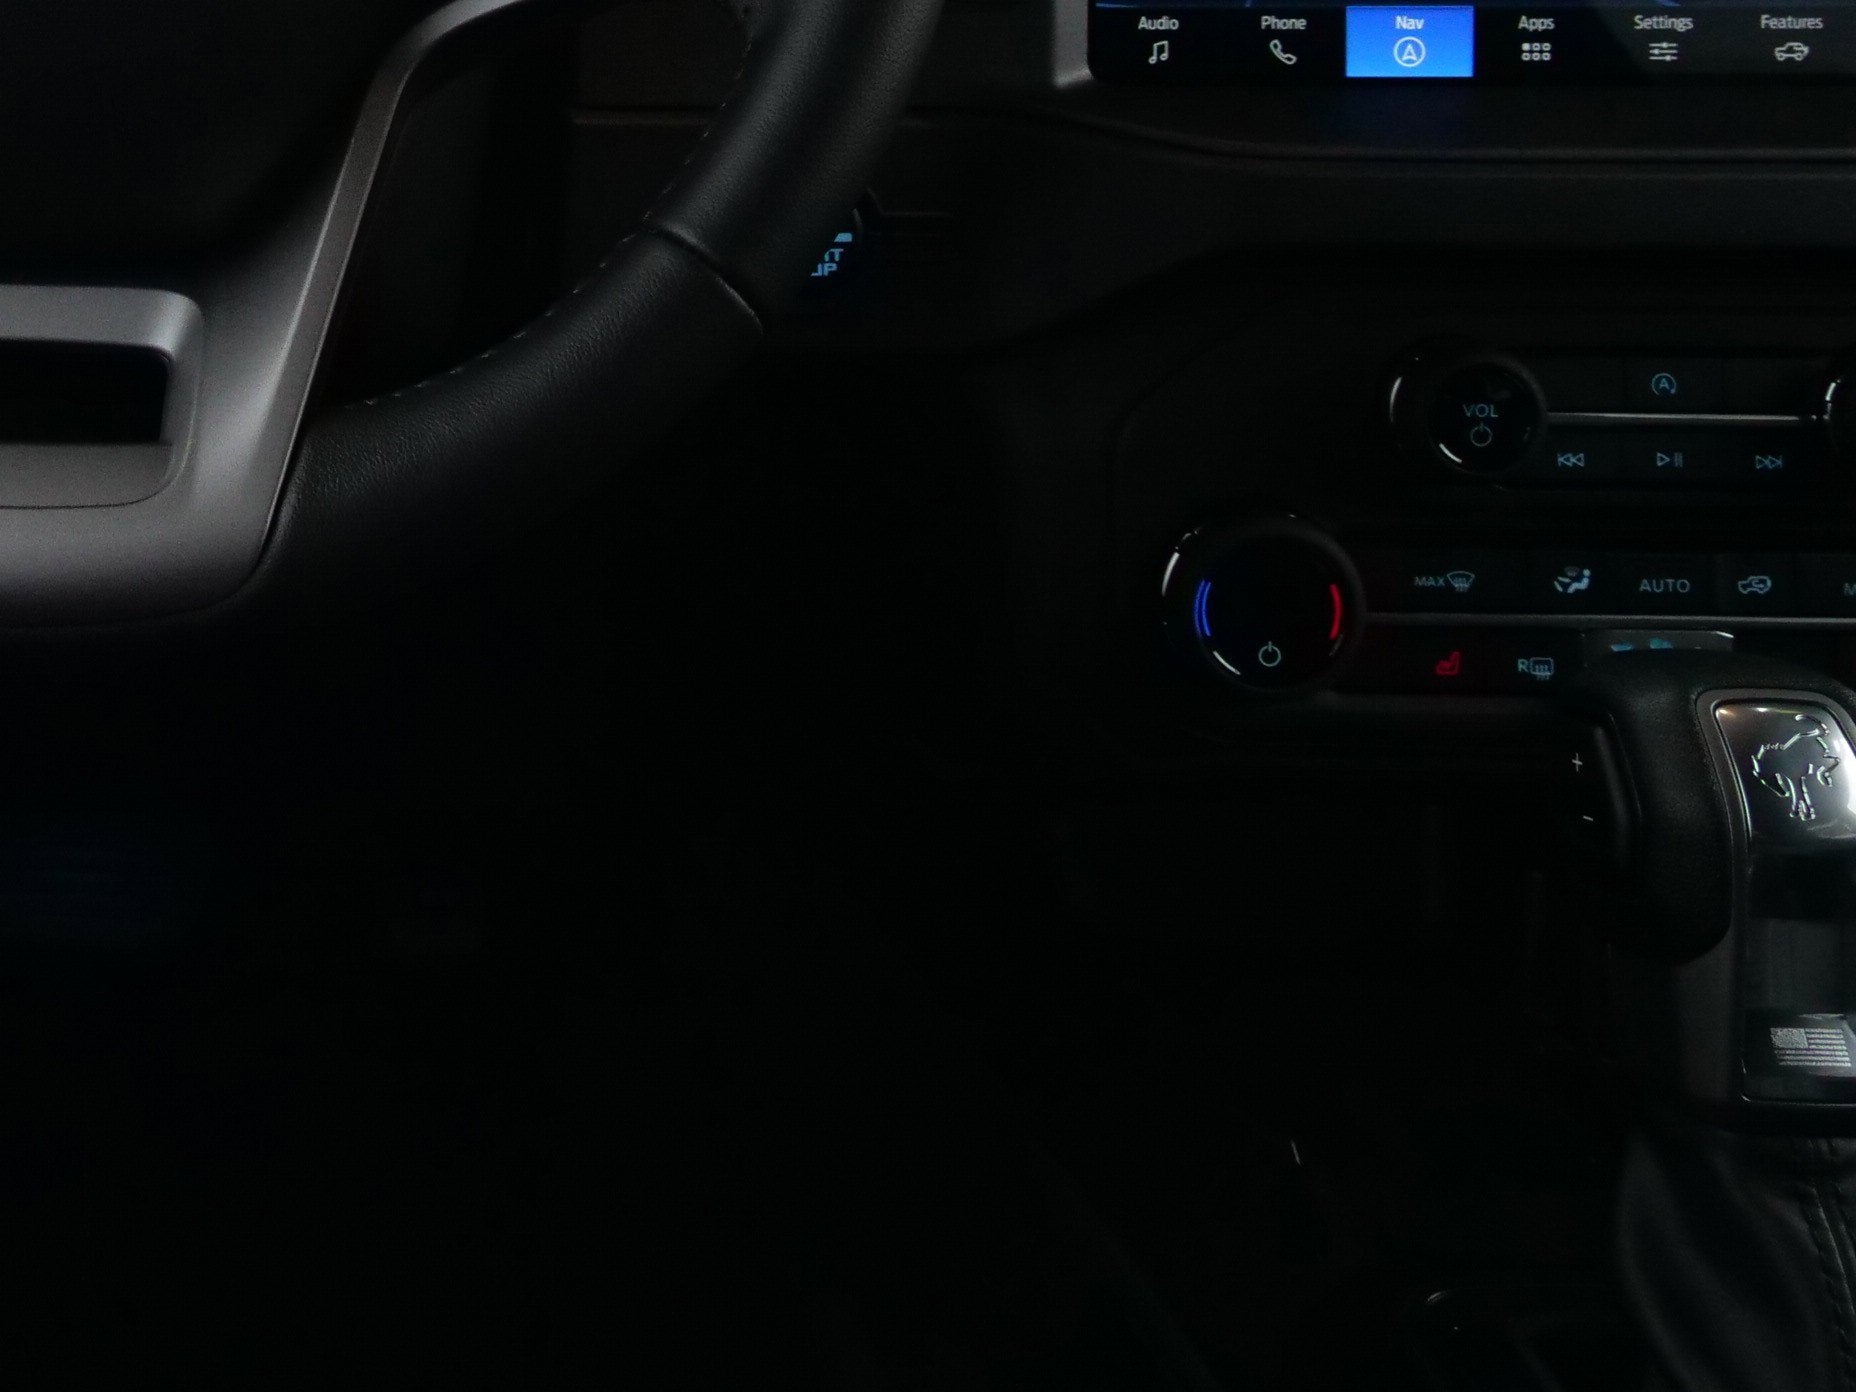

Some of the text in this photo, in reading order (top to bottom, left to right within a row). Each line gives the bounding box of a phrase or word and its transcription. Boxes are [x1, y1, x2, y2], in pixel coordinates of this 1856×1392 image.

[1137, 16, 1180, 31] Audio
[1260, 16, 1307, 31] Phone
[1394, 16, 1425, 30] Nav
[1517, 15, 1556, 32] Apps
[1633, 15, 1694, 33] Settings
[1760, 15, 1823, 30] Features
[1462, 403, 1499, 419] VOL
[1413, 574, 1445, 588] MAX
[1638, 578, 1692, 594] AUTO
